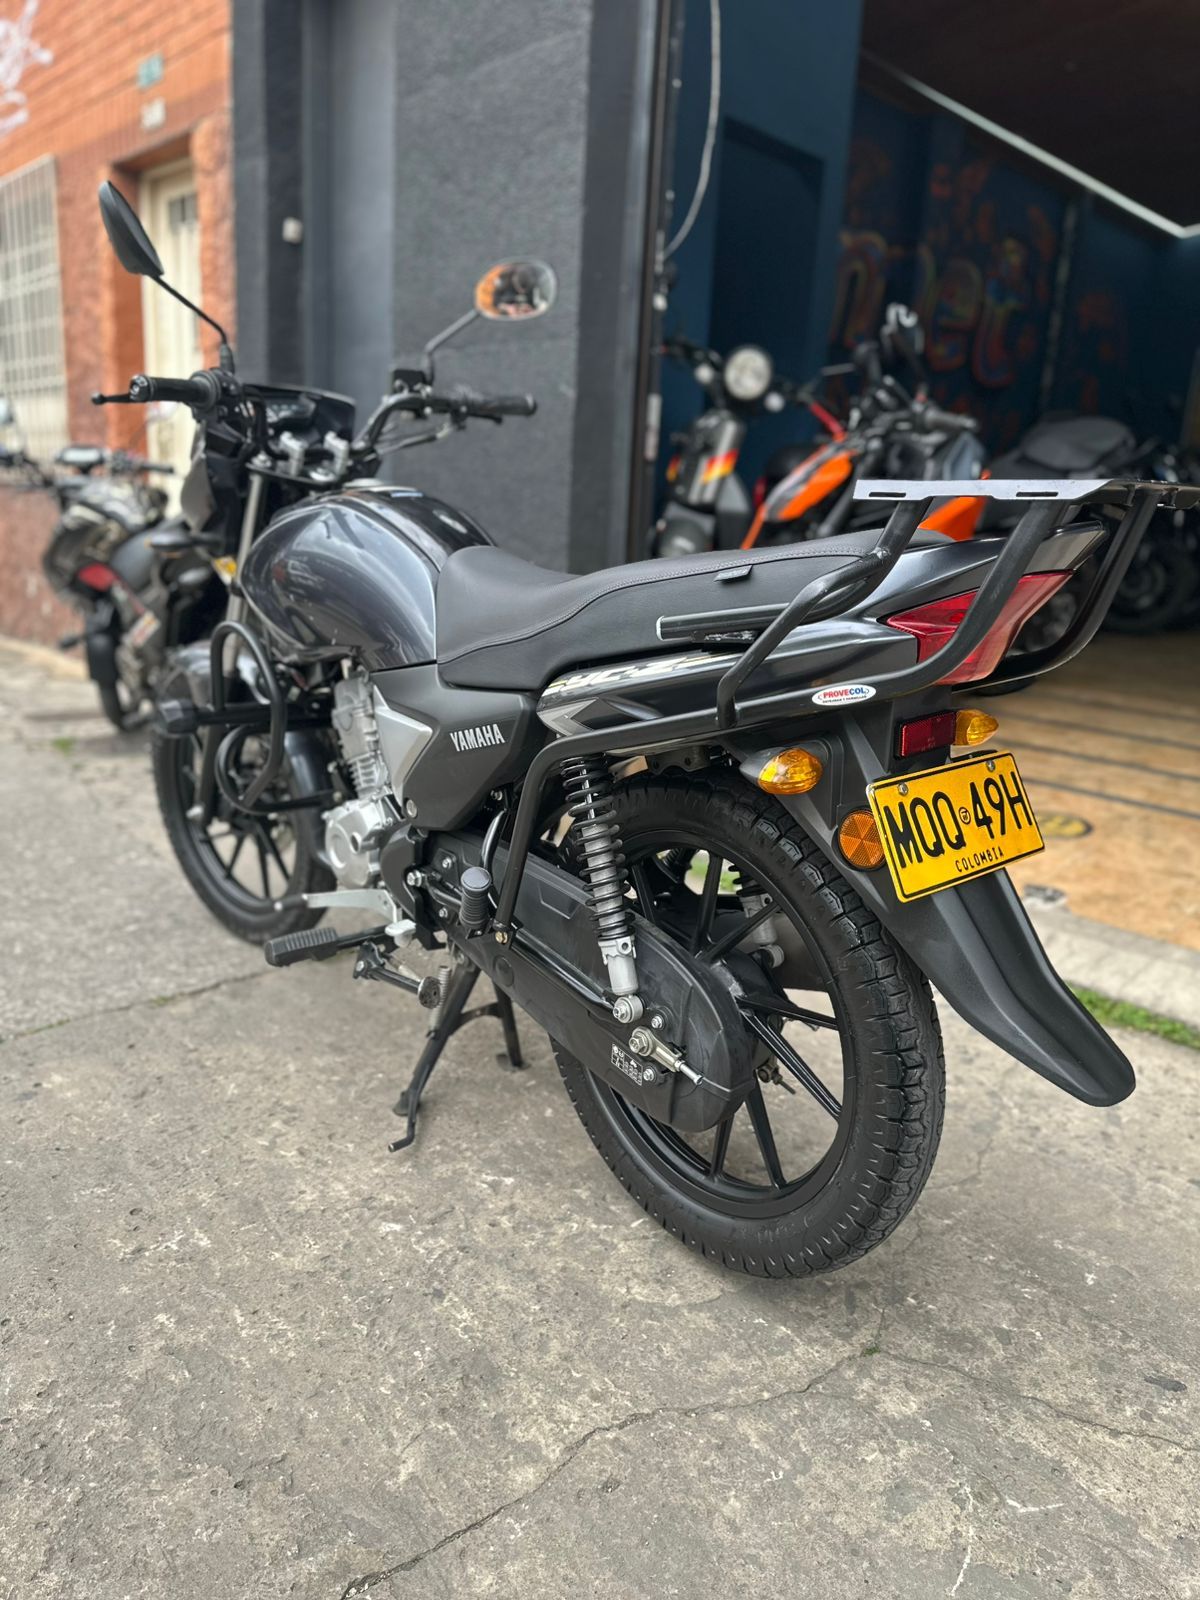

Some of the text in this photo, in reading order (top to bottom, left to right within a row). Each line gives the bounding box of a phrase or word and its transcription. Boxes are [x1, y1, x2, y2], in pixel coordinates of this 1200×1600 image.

[823, 687, 865, 699] PROVECOL
[450, 723, 505, 752] YAMAHA
[883, 771, 1033, 869] MQQ 49H
[955, 846, 1004, 872] COLOMBIA
